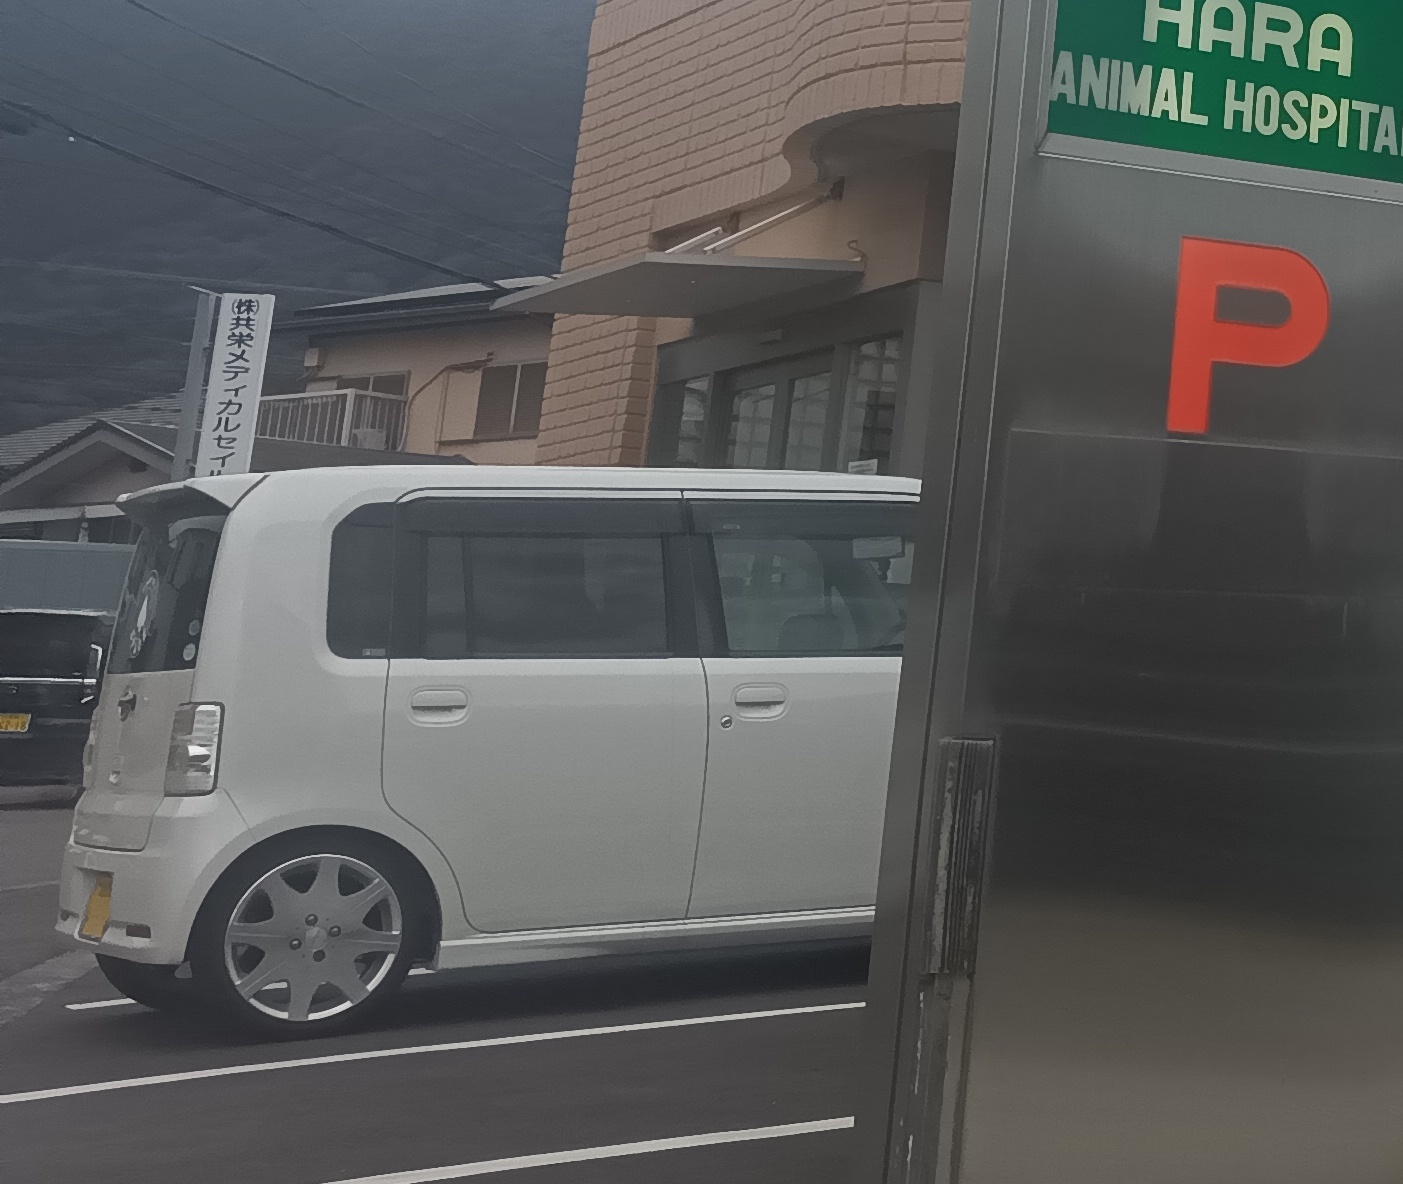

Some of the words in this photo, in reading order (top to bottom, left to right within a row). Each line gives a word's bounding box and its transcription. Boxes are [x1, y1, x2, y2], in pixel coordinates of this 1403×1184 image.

[1050, 50, 1208, 126] ANIMAL
[209, 298, 260, 476] ㈱共栄メディカルセイ
[1167, 235, 1331, 435] P
